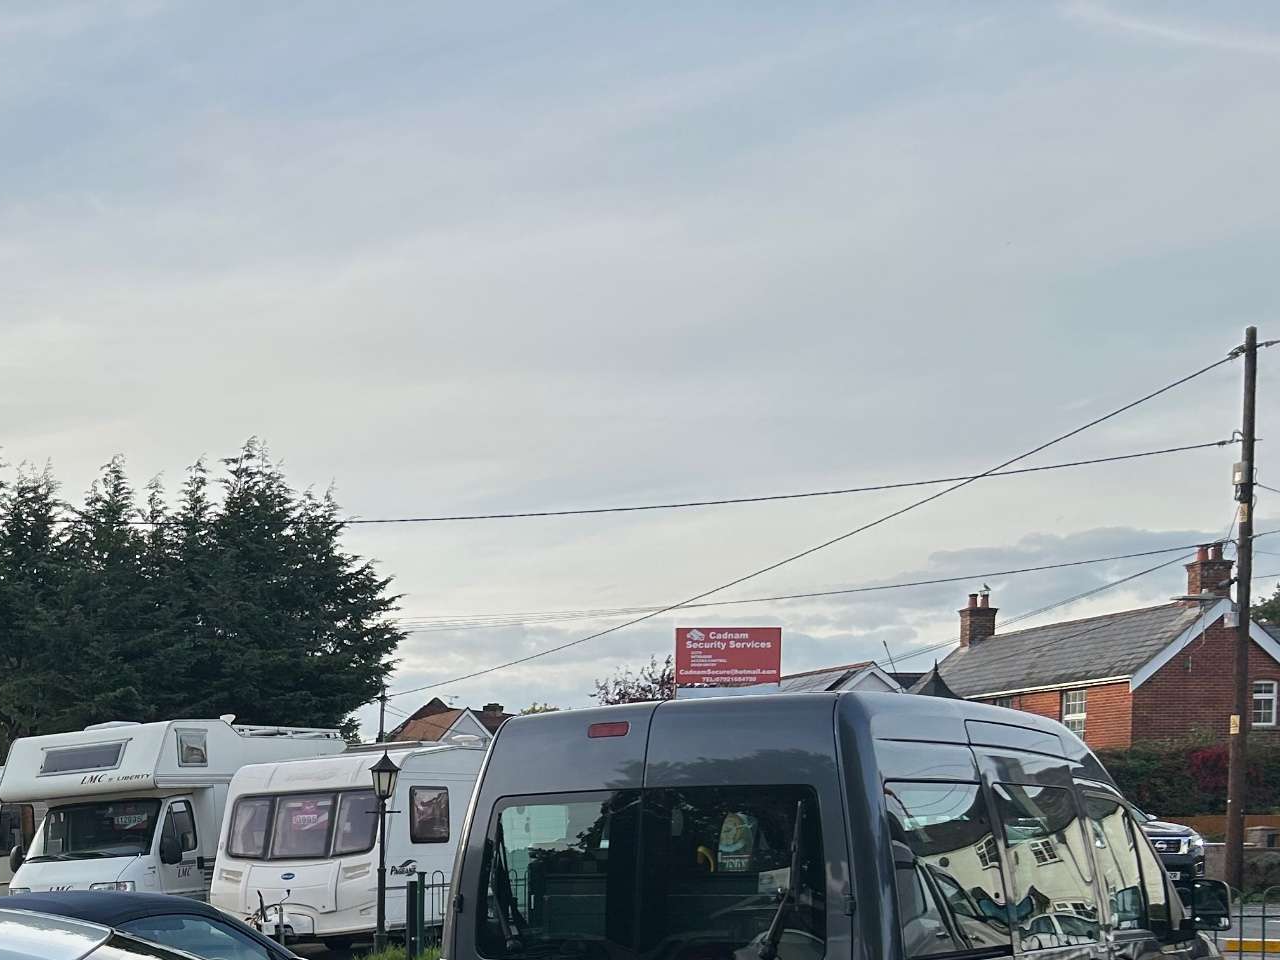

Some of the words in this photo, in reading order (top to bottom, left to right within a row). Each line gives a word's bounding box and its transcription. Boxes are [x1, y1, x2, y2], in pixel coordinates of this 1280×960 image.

[709, 631, 749, 640] Cadnam
[686, 641, 727, 650] Security
[729, 640, 772, 649] Services
[81, 773, 108, 785] LMC
